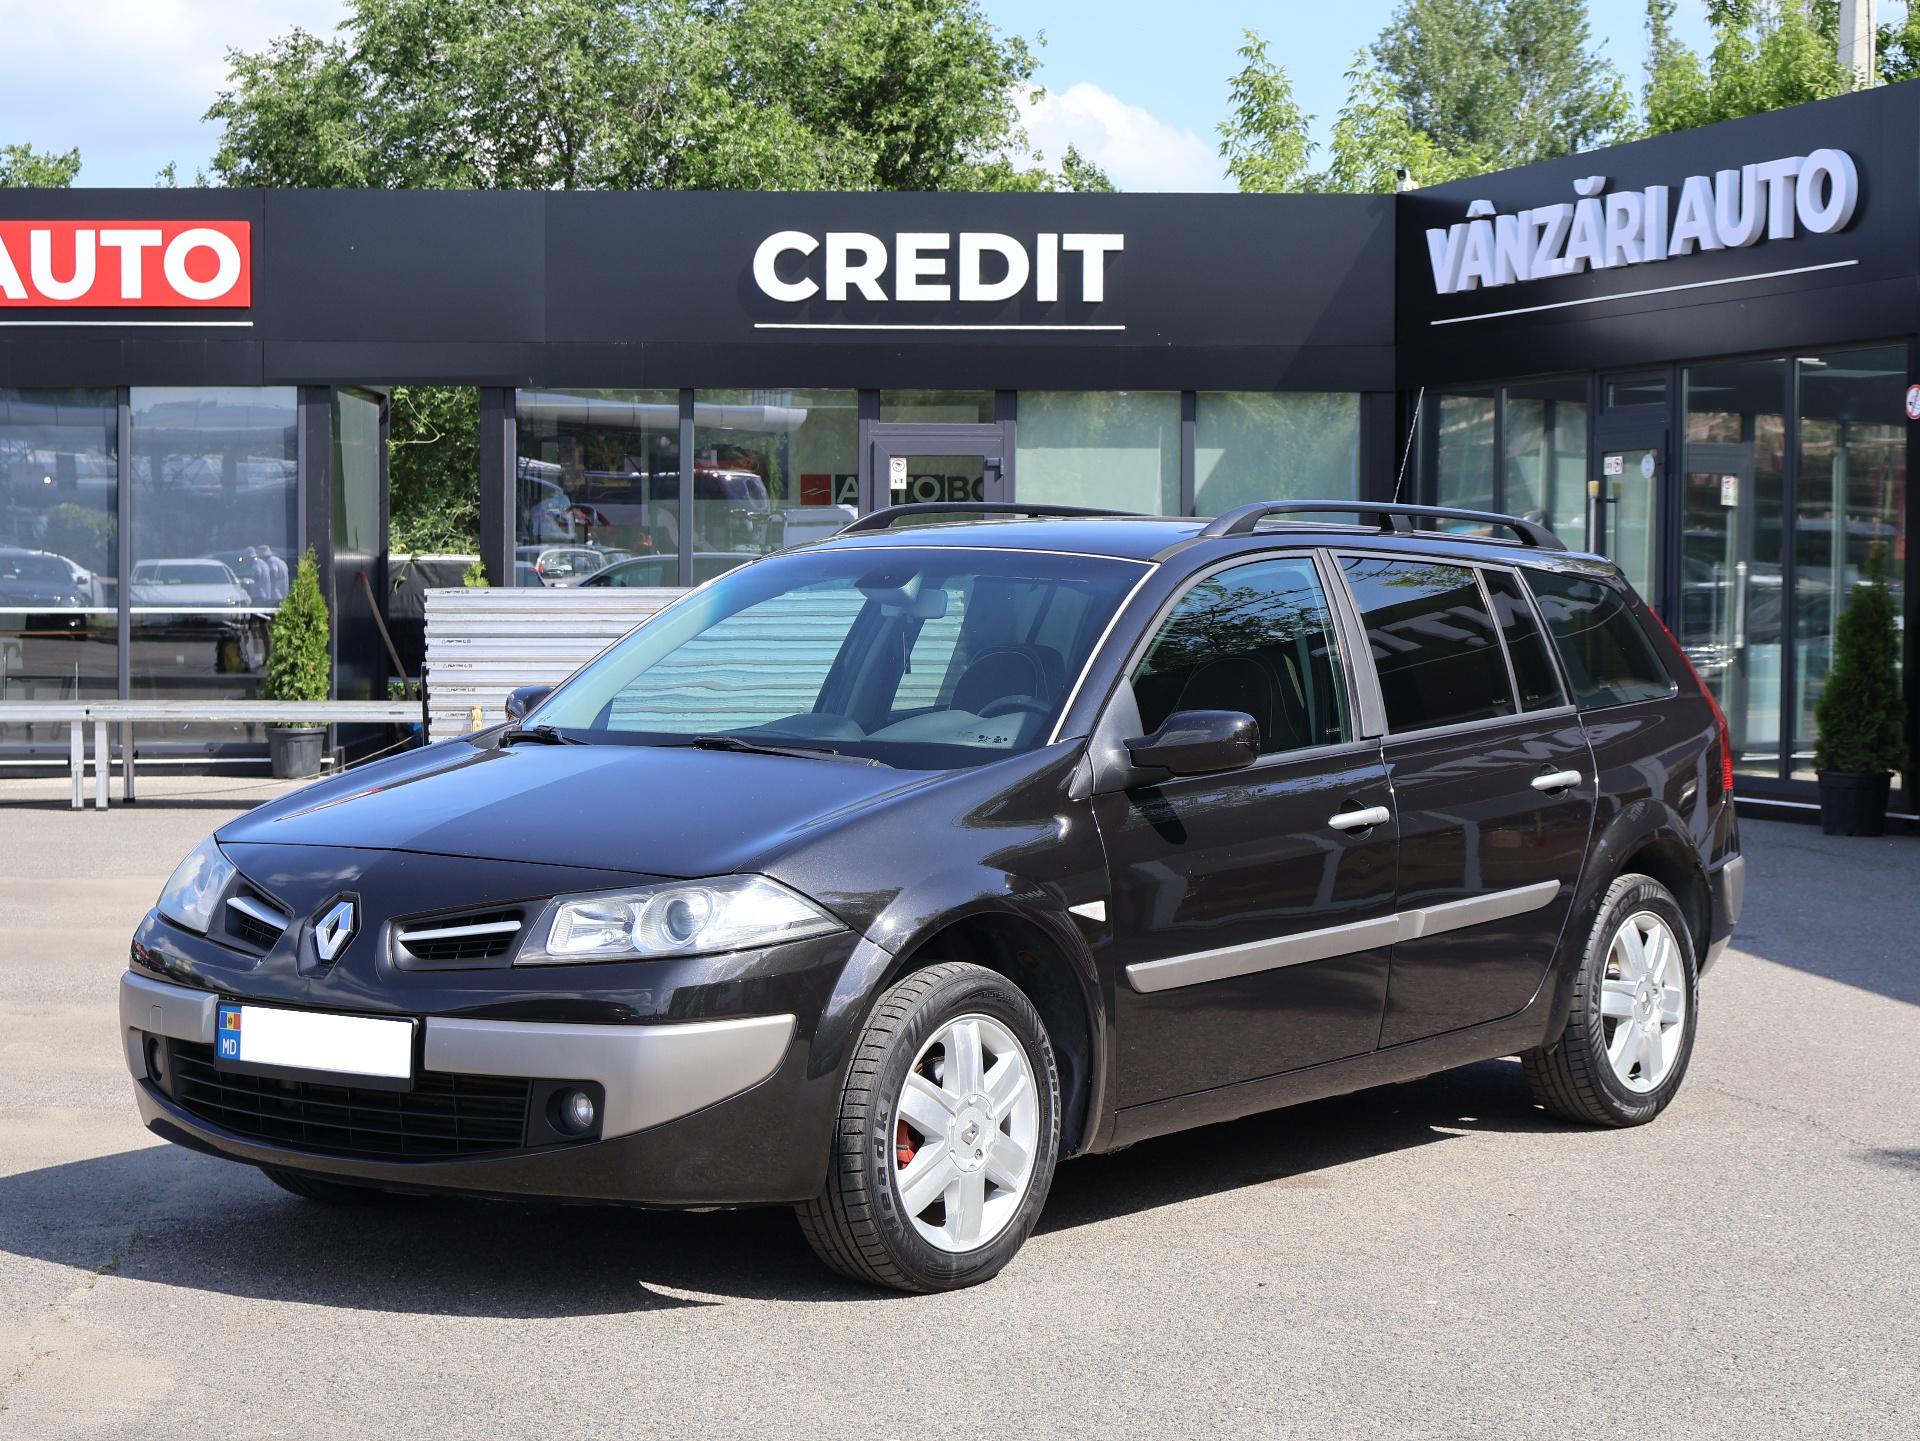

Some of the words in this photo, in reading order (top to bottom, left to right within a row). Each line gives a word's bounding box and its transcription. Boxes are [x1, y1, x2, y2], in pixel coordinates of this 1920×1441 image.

[1426, 176, 1669, 294] VÂNZĂRI
[1668, 148, 1858, 256] AUTO
[753, 230, 1124, 303] CREDIT
[222, 1038, 237, 1055] MD
